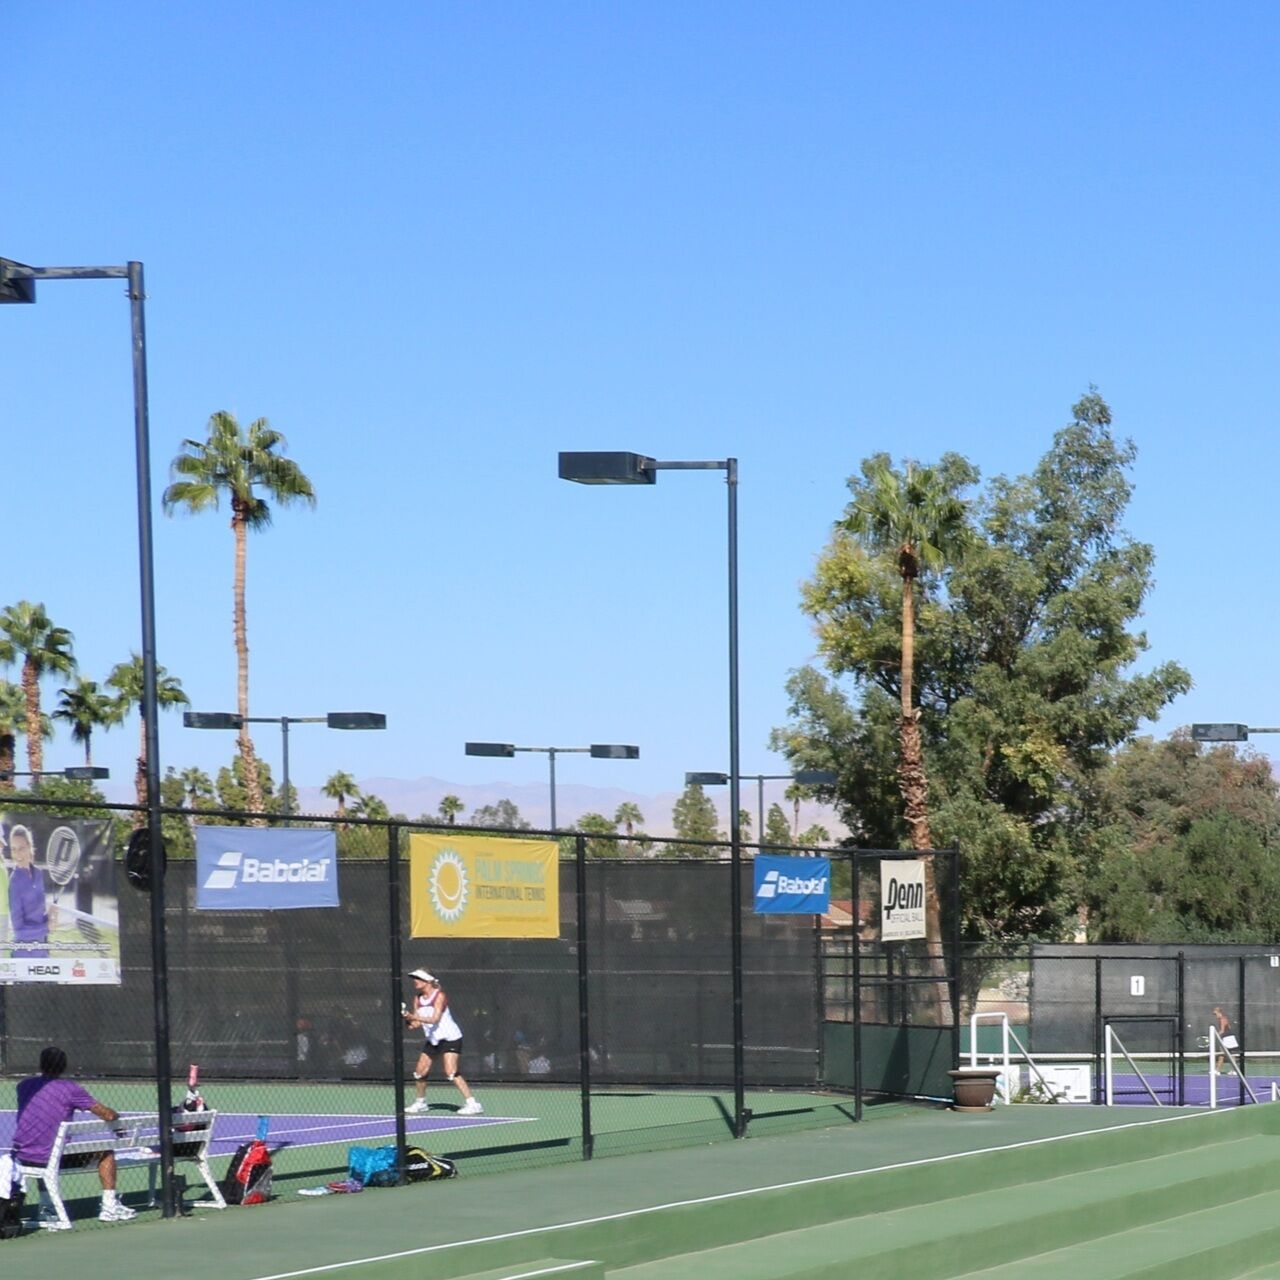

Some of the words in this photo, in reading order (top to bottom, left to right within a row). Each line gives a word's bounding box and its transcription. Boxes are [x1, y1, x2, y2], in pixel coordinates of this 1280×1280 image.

[242, 858, 330, 882] Babolat
[778, 876, 827, 894] Babolat
[883, 877, 923, 919] Penn
[28, 966, 60, 975] HEAD
